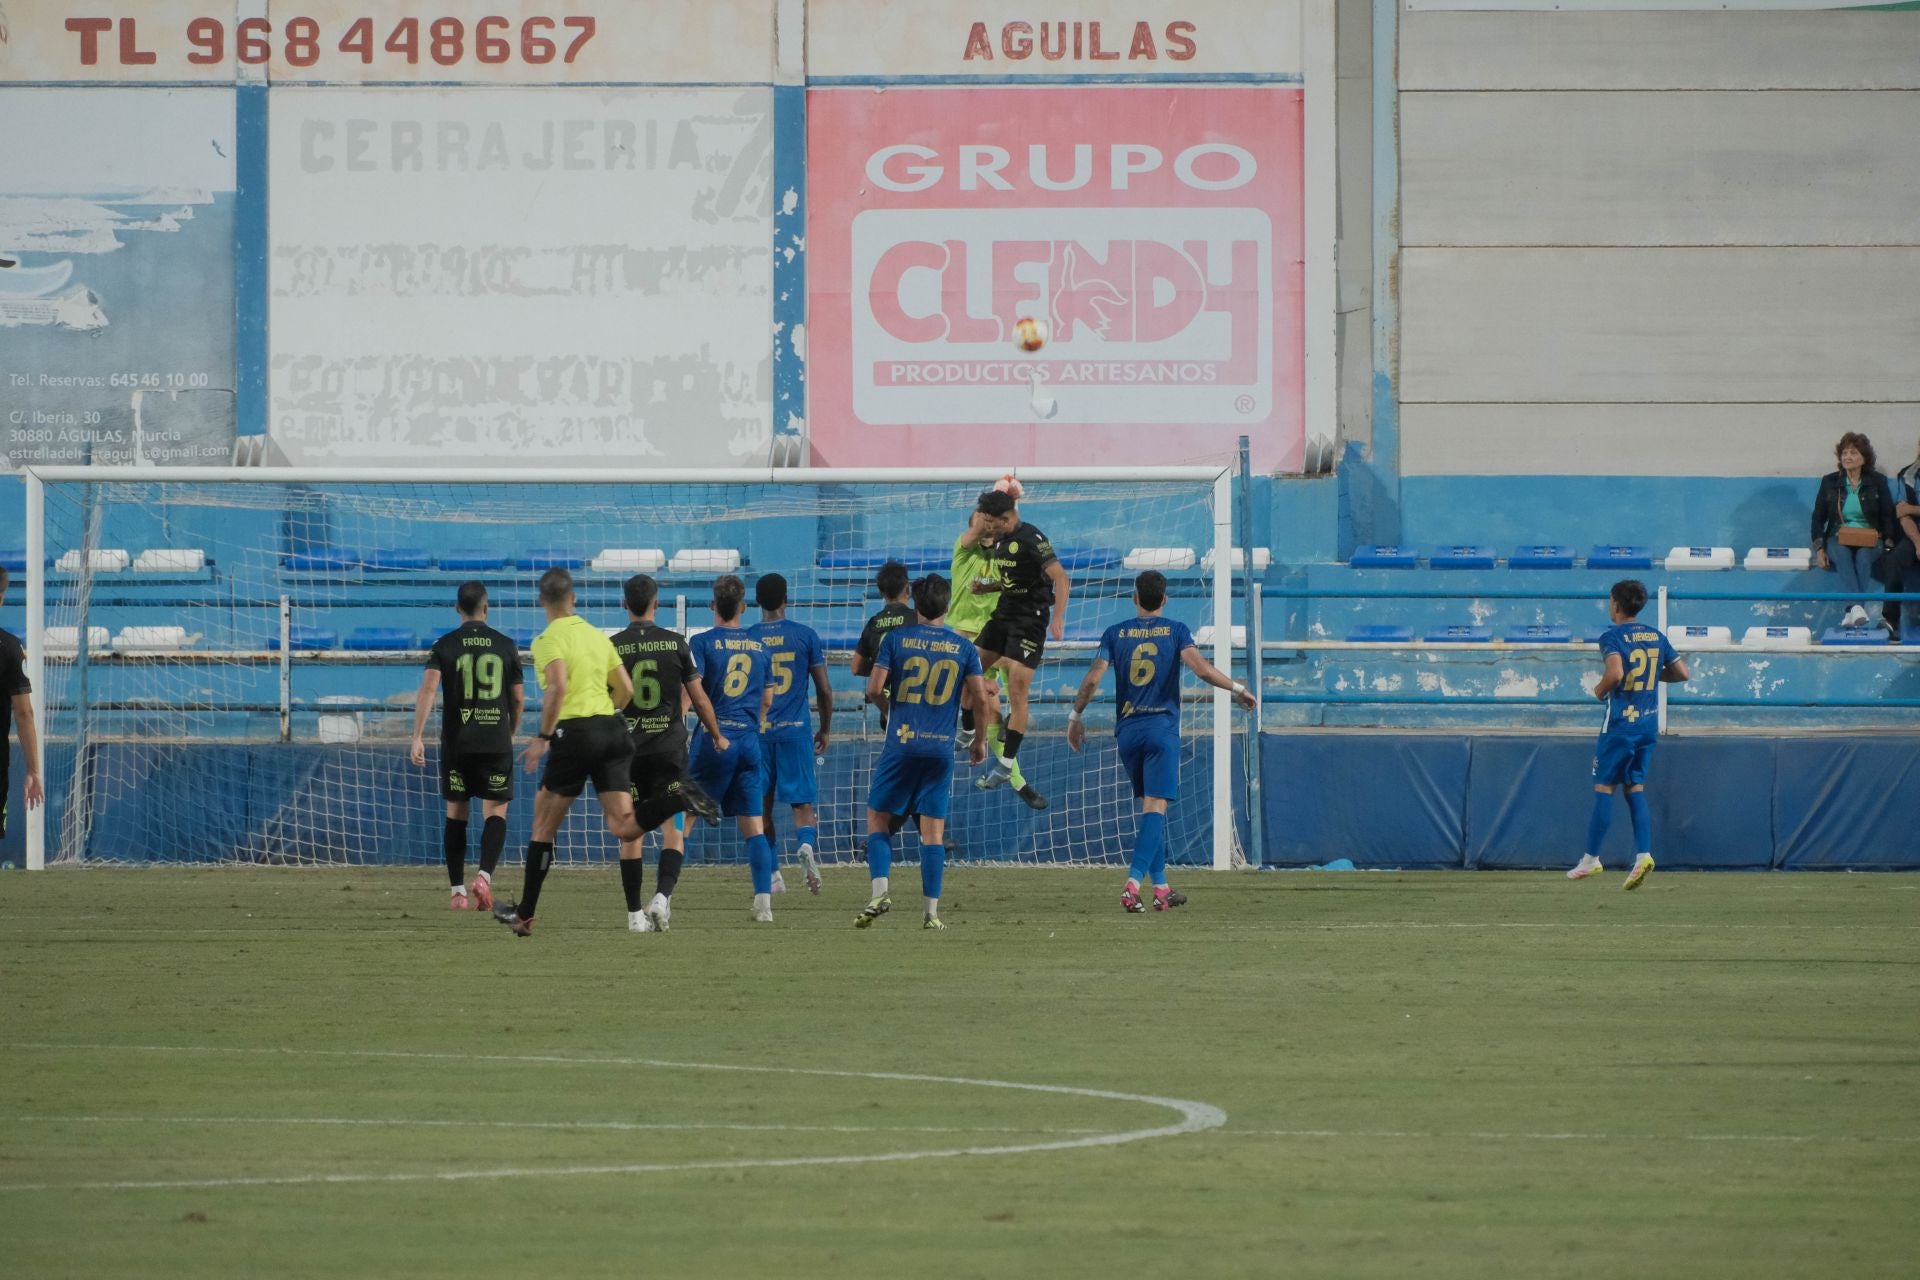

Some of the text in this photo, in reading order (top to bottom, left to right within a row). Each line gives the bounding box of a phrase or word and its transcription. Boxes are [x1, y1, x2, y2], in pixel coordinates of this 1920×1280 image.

[65, 17, 157, 66] TL
[963, 21, 1197, 62] AGUILAS
[299, 117, 703, 174] CERRAJERIA
[865, 143, 1258, 192] GRUPO
[9, 373, 34, 387] Tel.
[39, 373, 106, 387] Reservas:
[189, 372, 209, 387] 00
[890, 361, 1217, 384] PRODUCTOS ARTESANOS
[9, 429, 53, 442] 30880
[57, 426, 127, 445] ÁGUILAS,
[32, 410, 79, 425] Iberia,
[83, 410, 101, 424] 30
[462, 637, 492, 647] FRODO
[616, 641, 678, 655] OBE MORENO
[715, 639, 724, 650] A.
[902, 637, 929, 650] WILLY
[456, 652, 504, 700] 19
[632, 659, 661, 710] 6
[723, 653, 752, 698] 8
[896, 656, 960, 706] 20
[1129, 642, 1158, 687] 6
